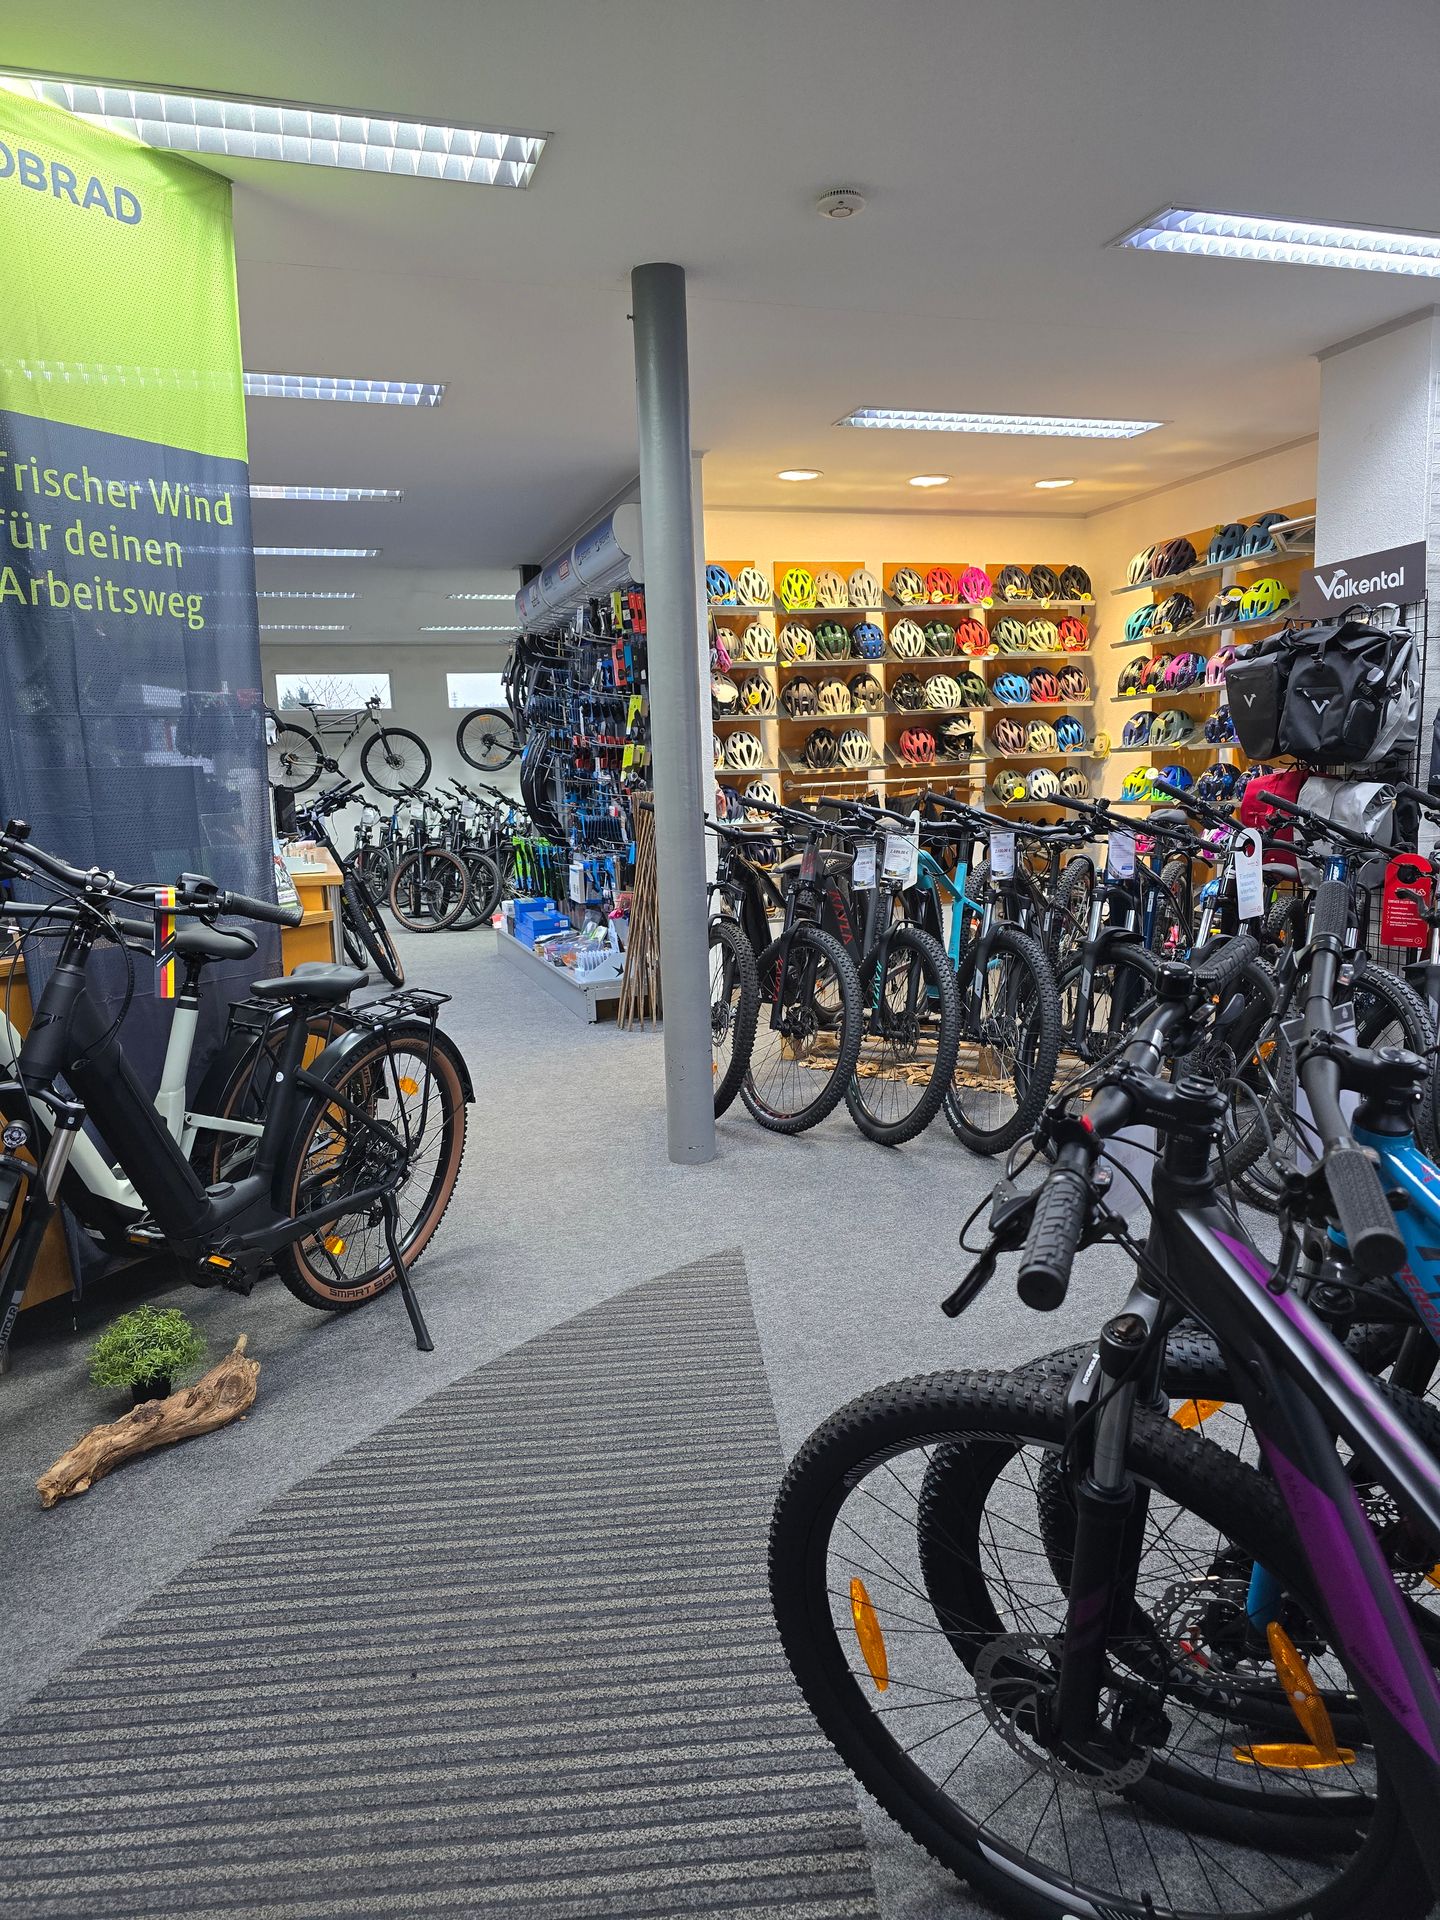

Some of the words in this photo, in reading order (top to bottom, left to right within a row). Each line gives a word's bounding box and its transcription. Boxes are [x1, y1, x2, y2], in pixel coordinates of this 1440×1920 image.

[149, 478, 234, 526] Wind
[65, 519, 183, 568] deinen
[0, 566, 205, 630] Arbeitsweg
[1314, 566, 1404, 601] Valkental
[1360, 972, 1417, 1036] SCHWALBE
[329, 1286, 371, 1298] SMART
[0, 1305, 19, 1350] NTOUR
